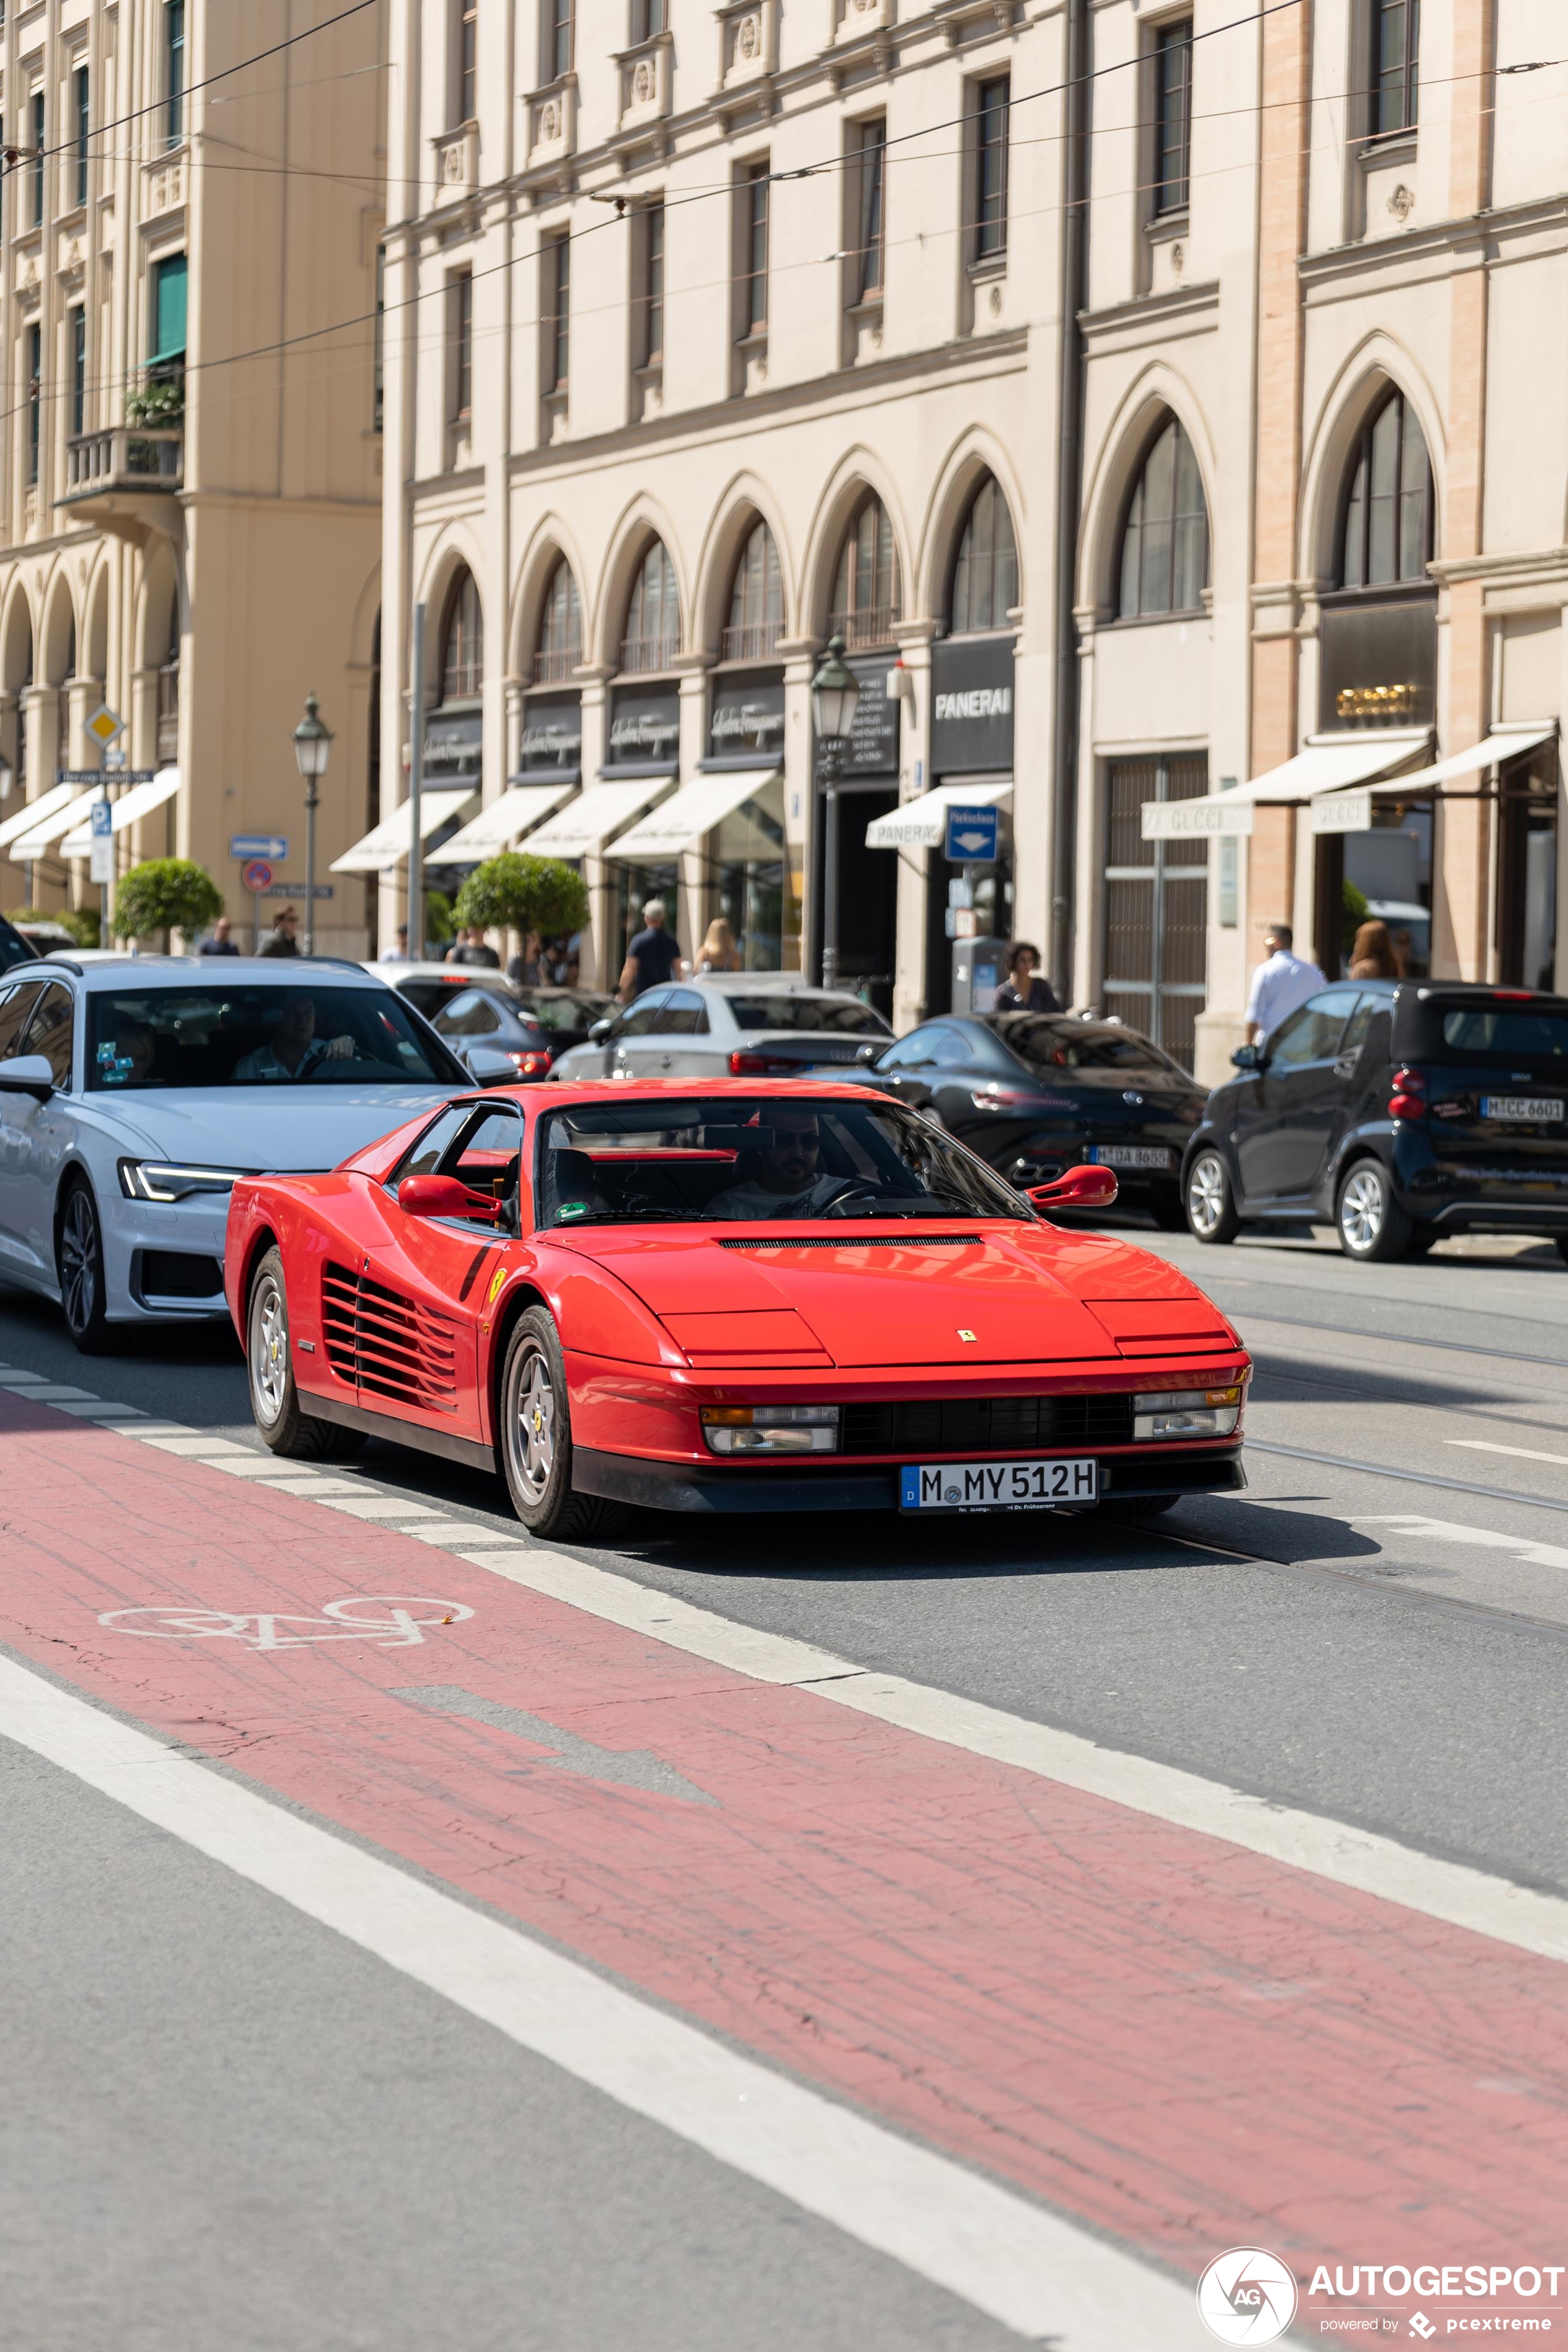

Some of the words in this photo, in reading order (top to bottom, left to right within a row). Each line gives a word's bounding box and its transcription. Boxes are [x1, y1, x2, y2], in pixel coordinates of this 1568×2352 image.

[936, 686, 1011, 720] PANERAI
[950, 812, 994, 824] Parkschein
[1171, 808, 1222, 831] GUCCI
[1319, 804, 1359, 824] GUCCI
[1489, 1100, 1498, 1114] M
[1507, 1101, 1524, 1115] CC
[1528, 1102, 1560, 1117] 6601
[1098, 1149, 1106, 1161] M
[922, 1470, 941, 1501] M
[907, 1491, 914, 1500] D
